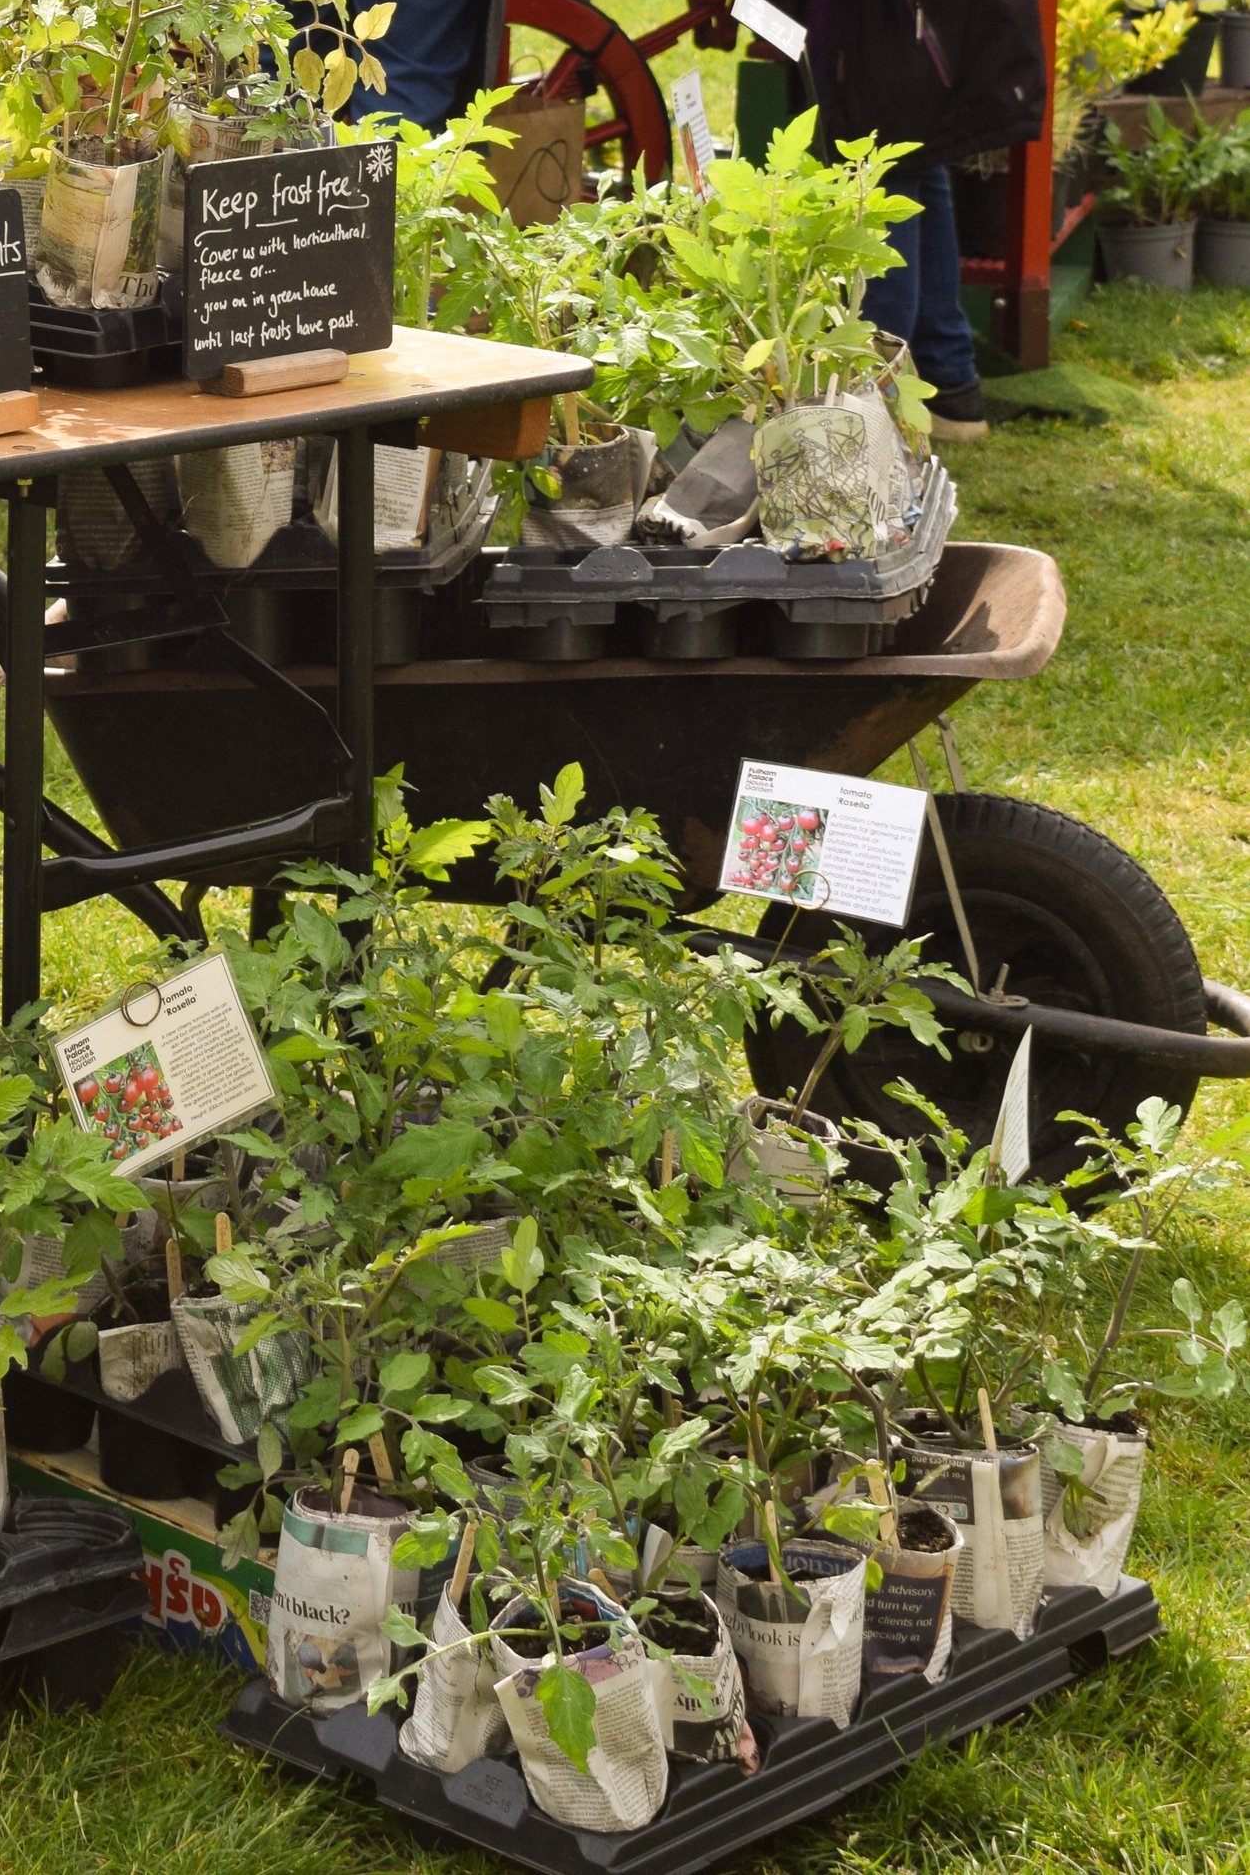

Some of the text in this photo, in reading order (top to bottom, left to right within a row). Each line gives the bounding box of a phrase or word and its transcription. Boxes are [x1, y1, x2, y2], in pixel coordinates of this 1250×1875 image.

[203, 159, 363, 229] Keep frost free!
[242, 247, 255, 260] us
[260, 236, 288, 256] with
[294, 222, 366, 249] horticultural
[200, 267, 243, 290] fleece
[200, 281, 338, 325] grow on in greenhouse
[194, 309, 359, 351] until last frosts have past.
[747, 773, 773, 782] Palace
[748, 767, 777, 777] Fulham
[745, 784, 773, 794] Garden
[840, 787, 873, 799] tomato
[161, 984, 193, 1005] Tomato
[63, 1036, 90, 1055] Fulham
[66, 1044, 91, 1061] Palace
[70, 1056, 97, 1074] Garden
[291, 1599, 351, 1626] black?
[875, 1601, 922, 1614] turn key
[877, 1615, 933, 1628] clients not
[909, 1632, 920, 1642] in
